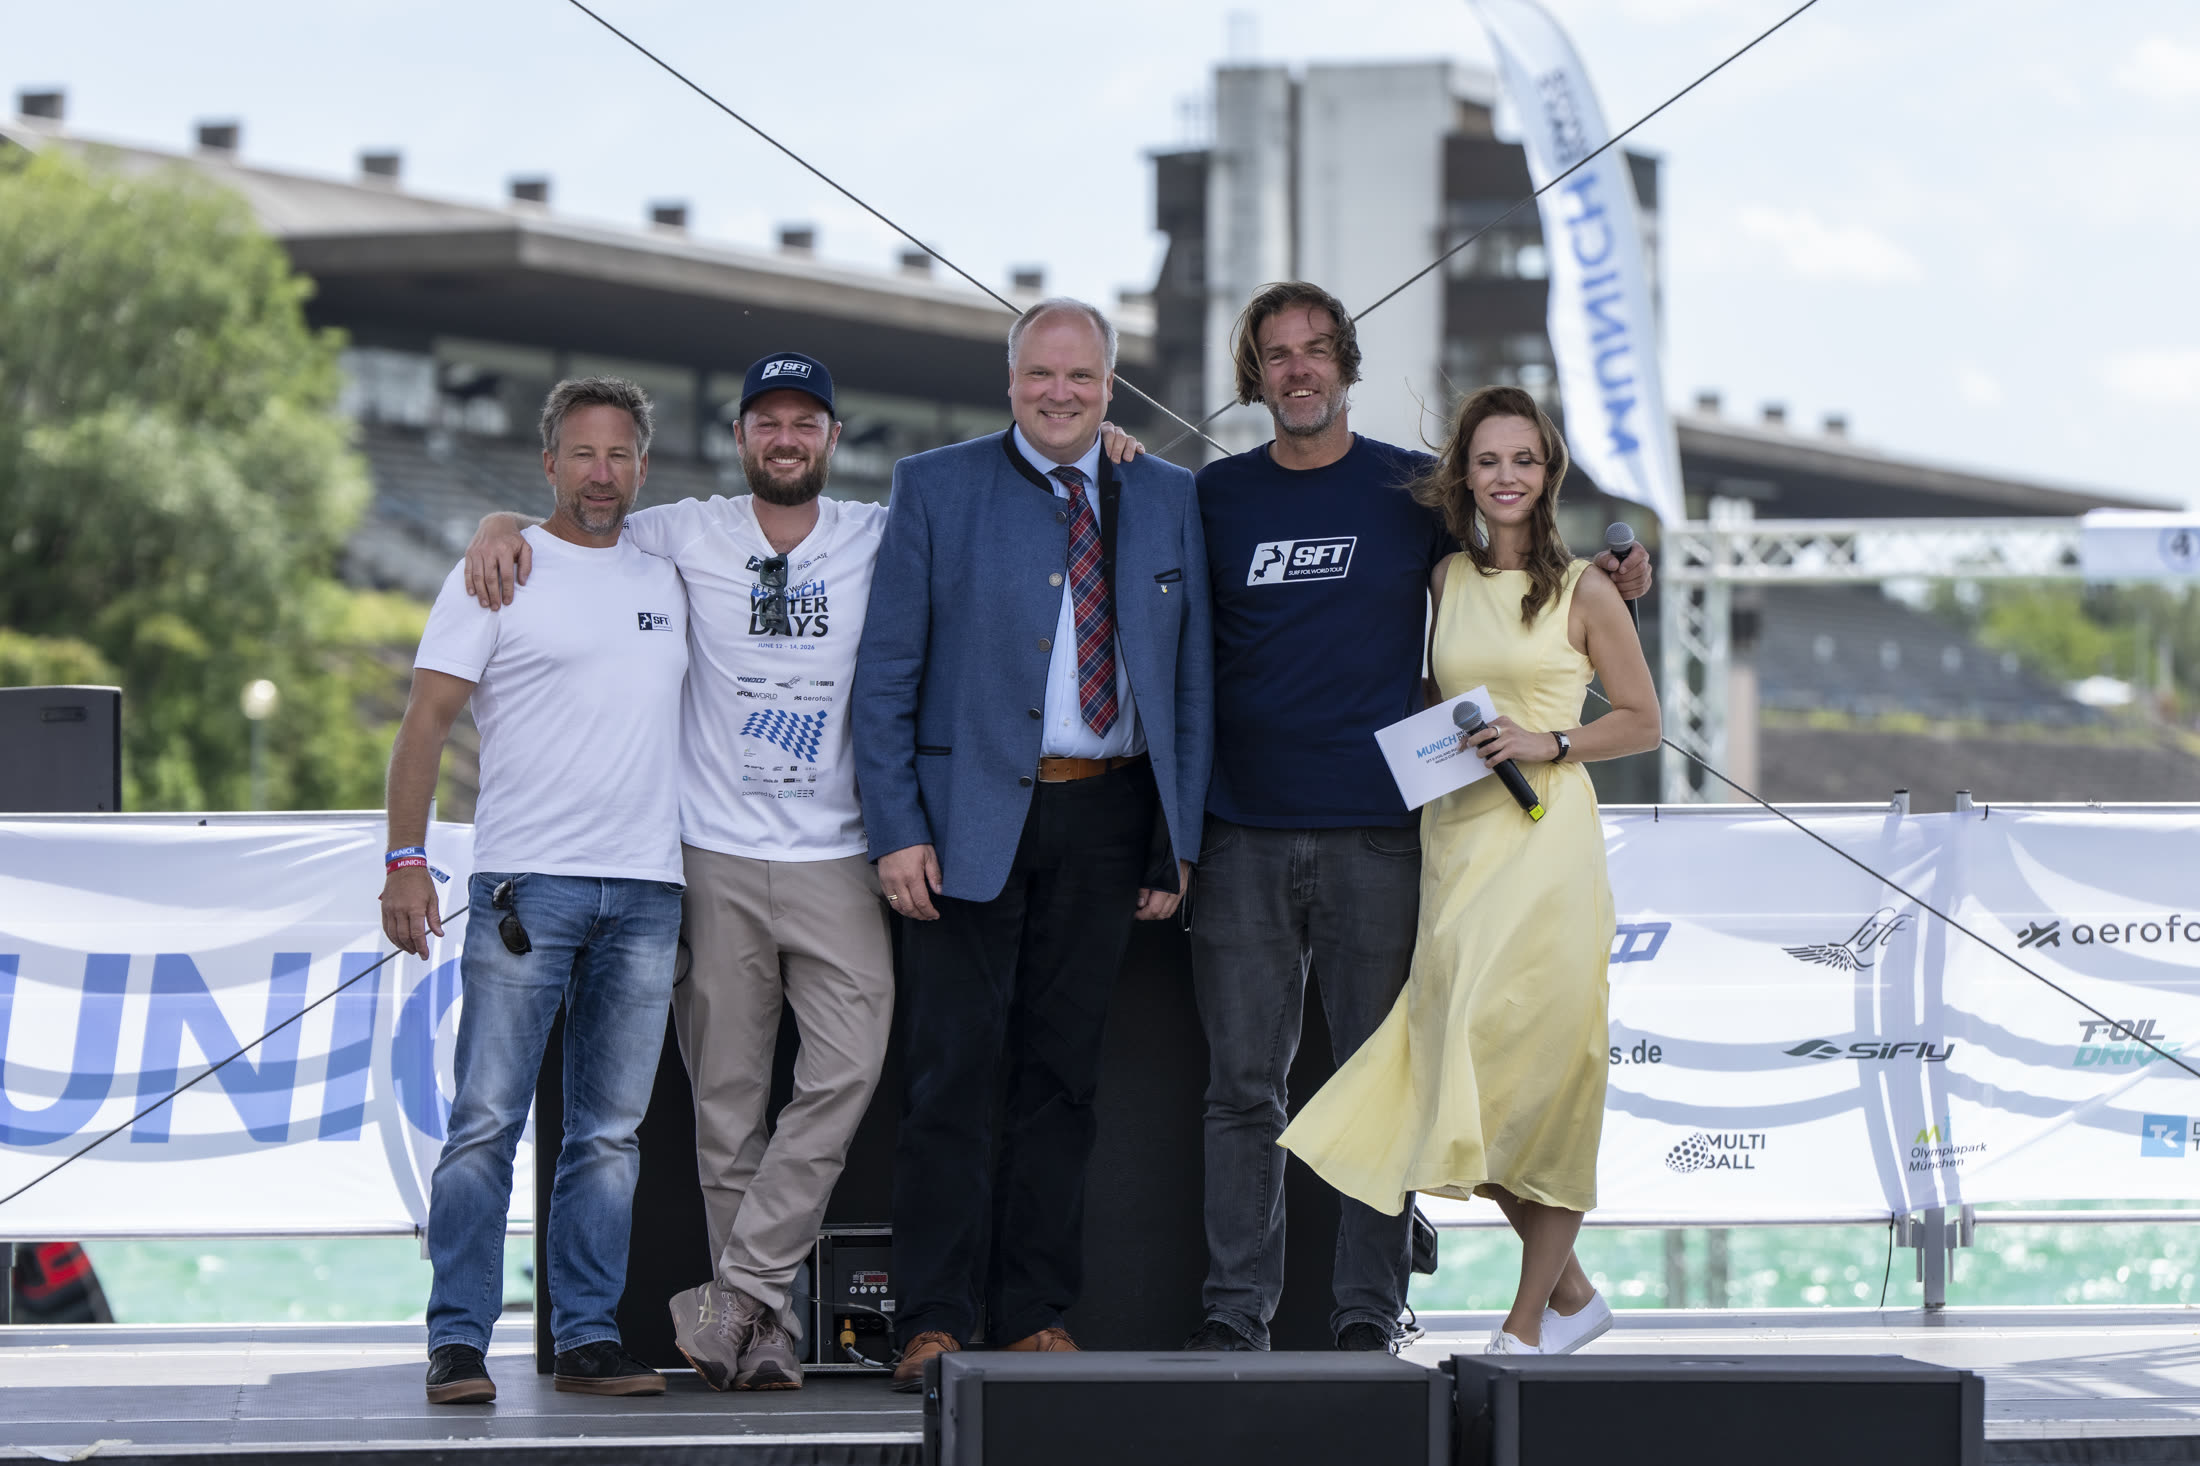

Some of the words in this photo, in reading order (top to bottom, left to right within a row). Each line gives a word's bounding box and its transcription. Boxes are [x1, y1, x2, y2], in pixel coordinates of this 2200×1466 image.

[782, 362, 809, 372] SFT
[1293, 544, 1350, 566] SFT
[750, 596, 829, 615] WTER
[652, 615, 669, 626] SFT
[1416, 733, 1457, 759] MUNICH
[391, 848, 414, 857] MUNICH
[1706, 1133, 1766, 1150] MULTI
[1911, 1142, 1987, 1160] Olympiapark
[1704, 1154, 1755, 1170] BALL
[1908, 1158, 1965, 1172] München
